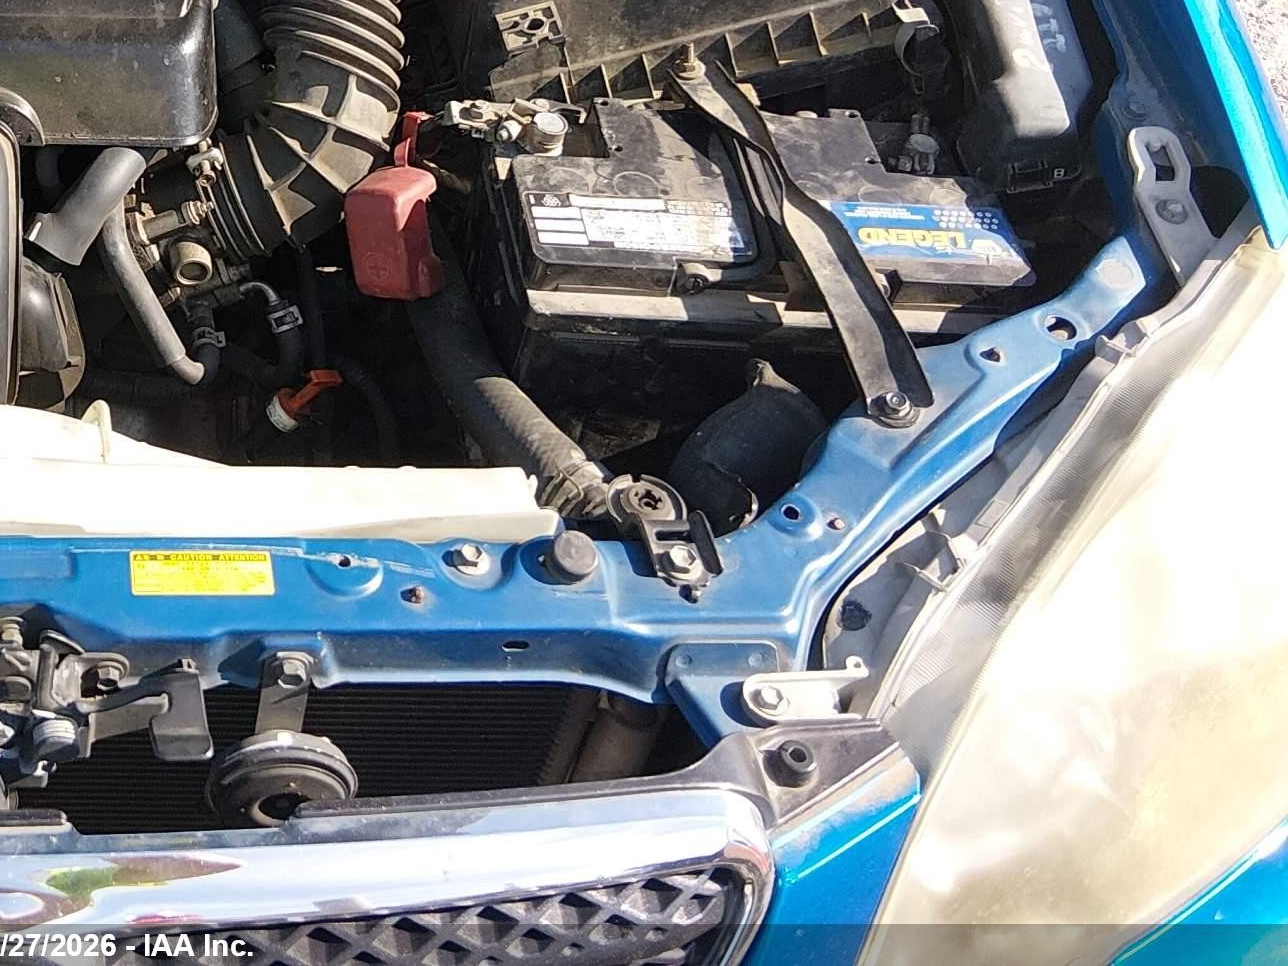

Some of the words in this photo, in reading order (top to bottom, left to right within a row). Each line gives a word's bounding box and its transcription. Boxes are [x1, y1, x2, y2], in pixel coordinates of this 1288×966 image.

[858, 227, 967, 250] LEGEND
[169, 553, 213, 562] CAUTION
[218, 553, 267, 562] ATTENTION
